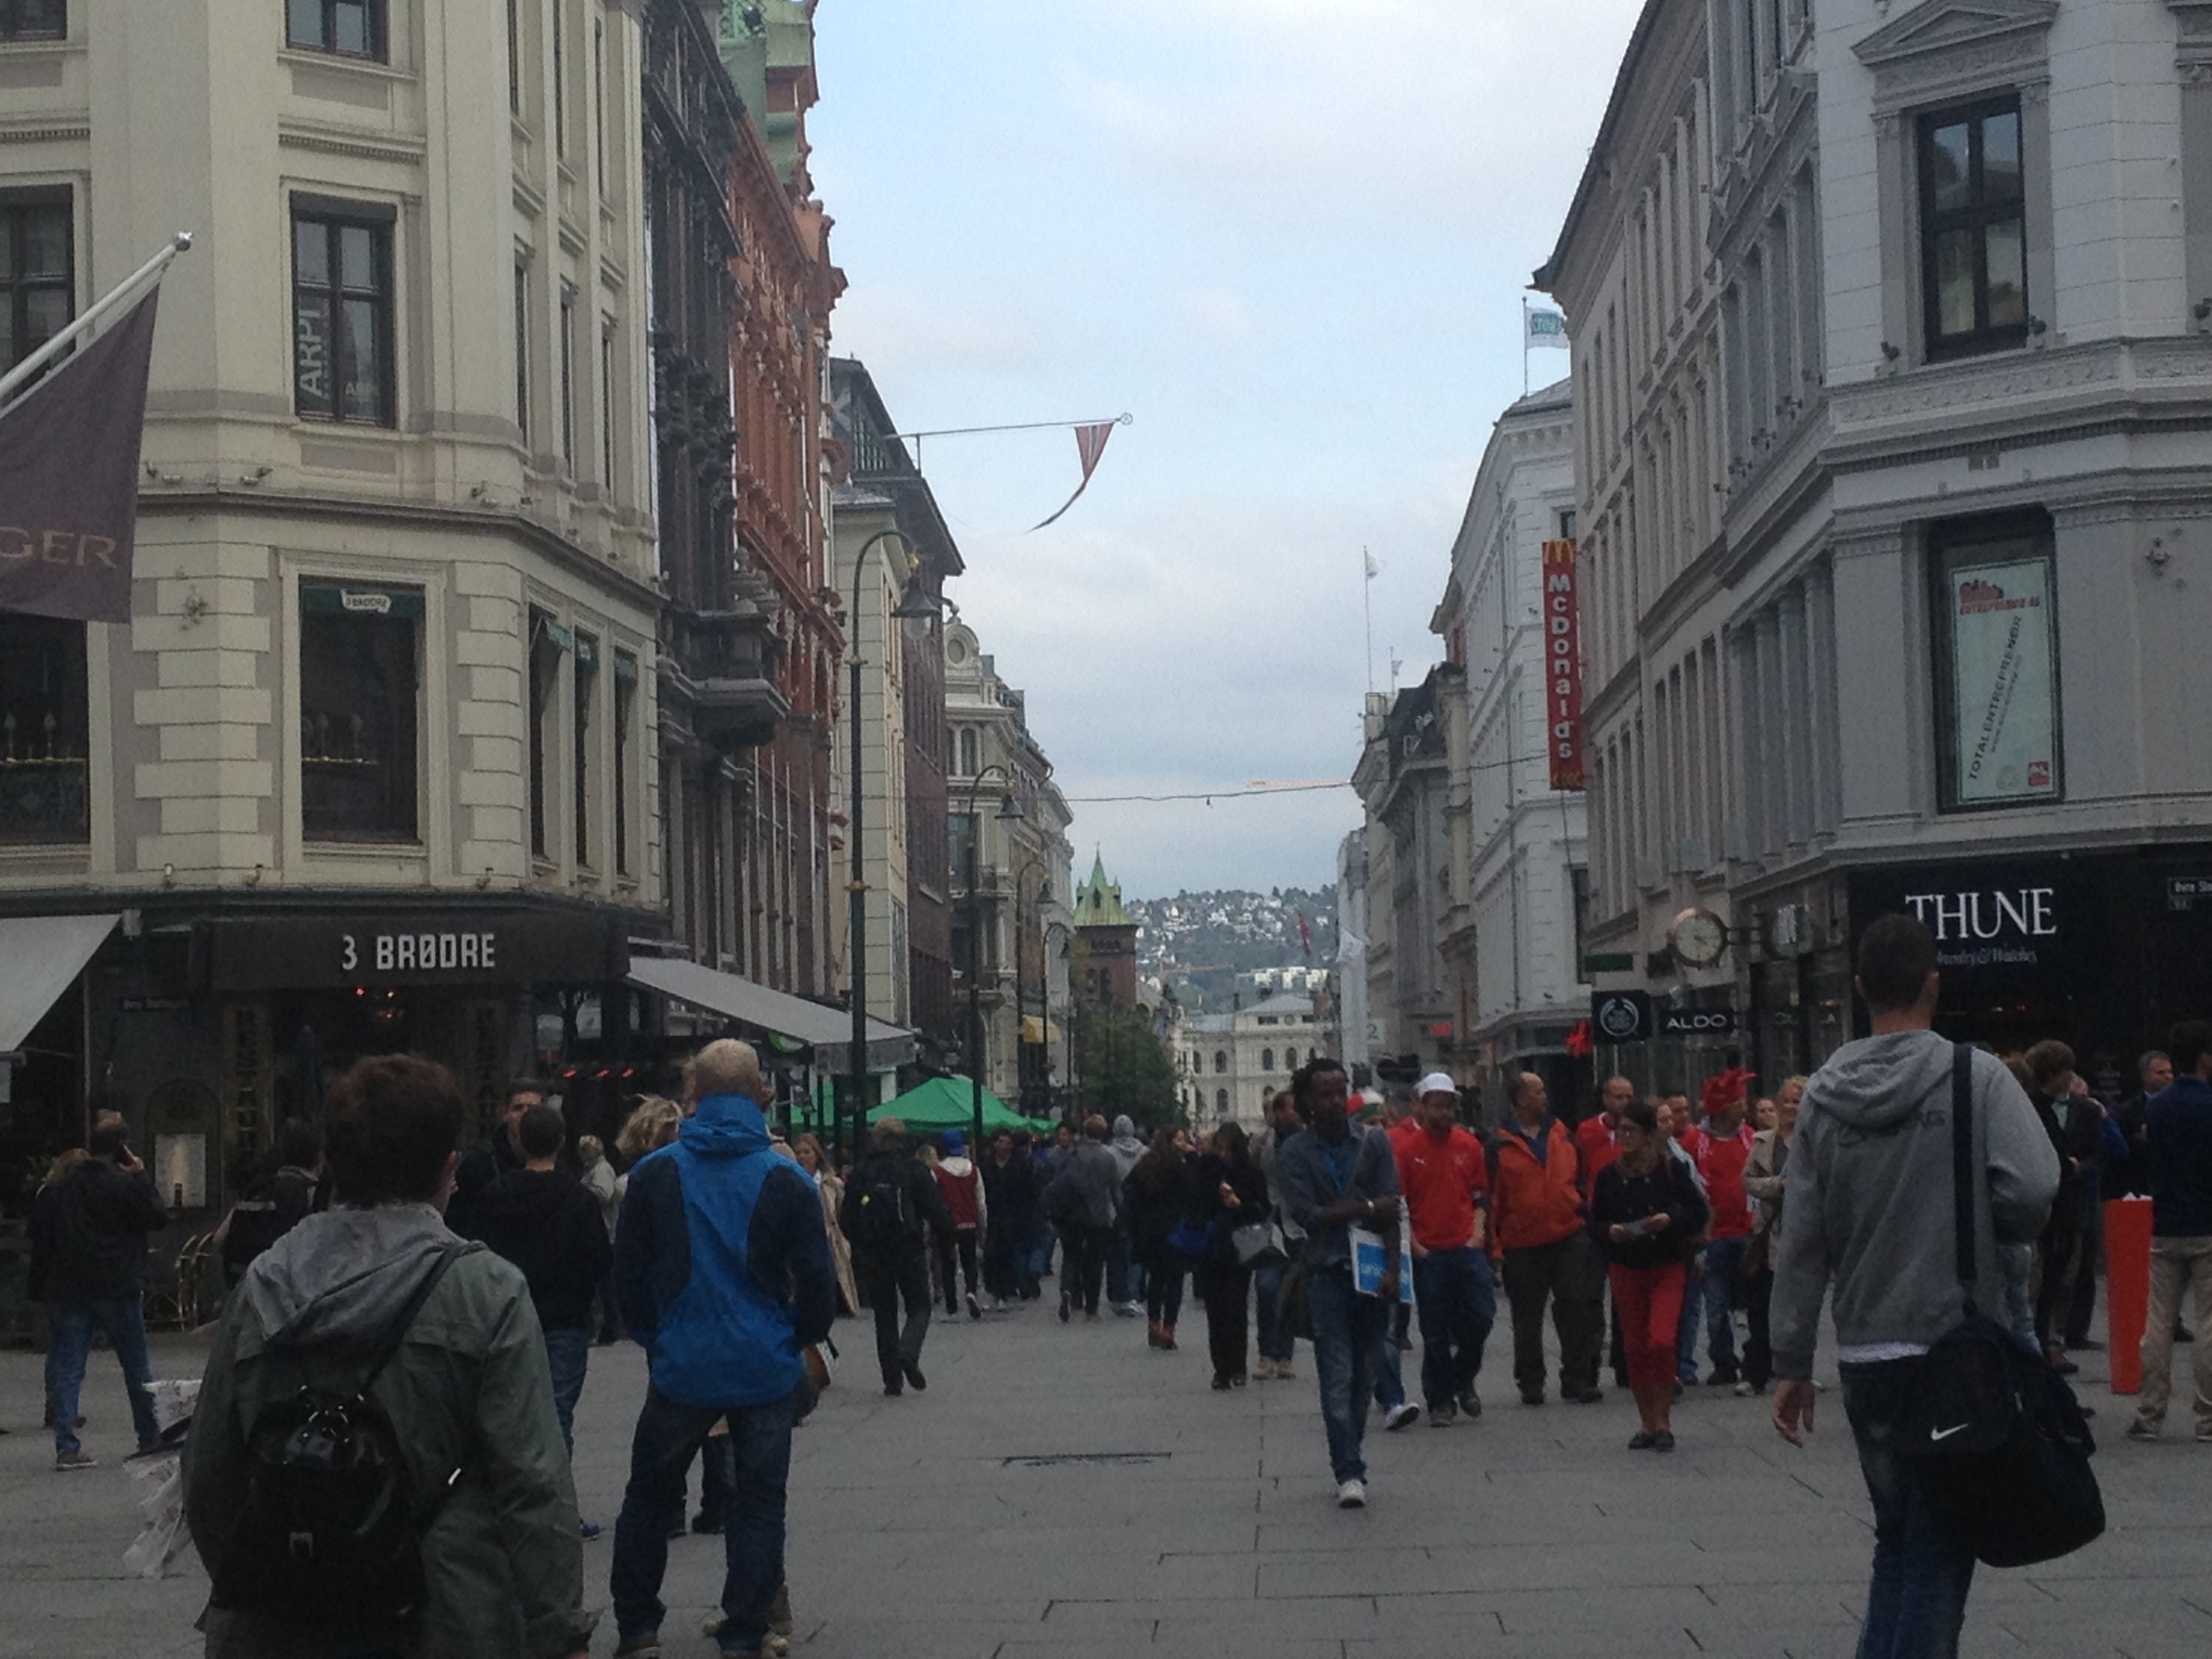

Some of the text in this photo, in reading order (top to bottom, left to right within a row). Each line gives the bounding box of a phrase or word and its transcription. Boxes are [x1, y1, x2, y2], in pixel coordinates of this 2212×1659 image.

[1904, 888, 2058, 940] THUNE
[342, 933, 495, 970] 3 BRØDRE
[1665, 1013, 1727, 1029] ALDO
